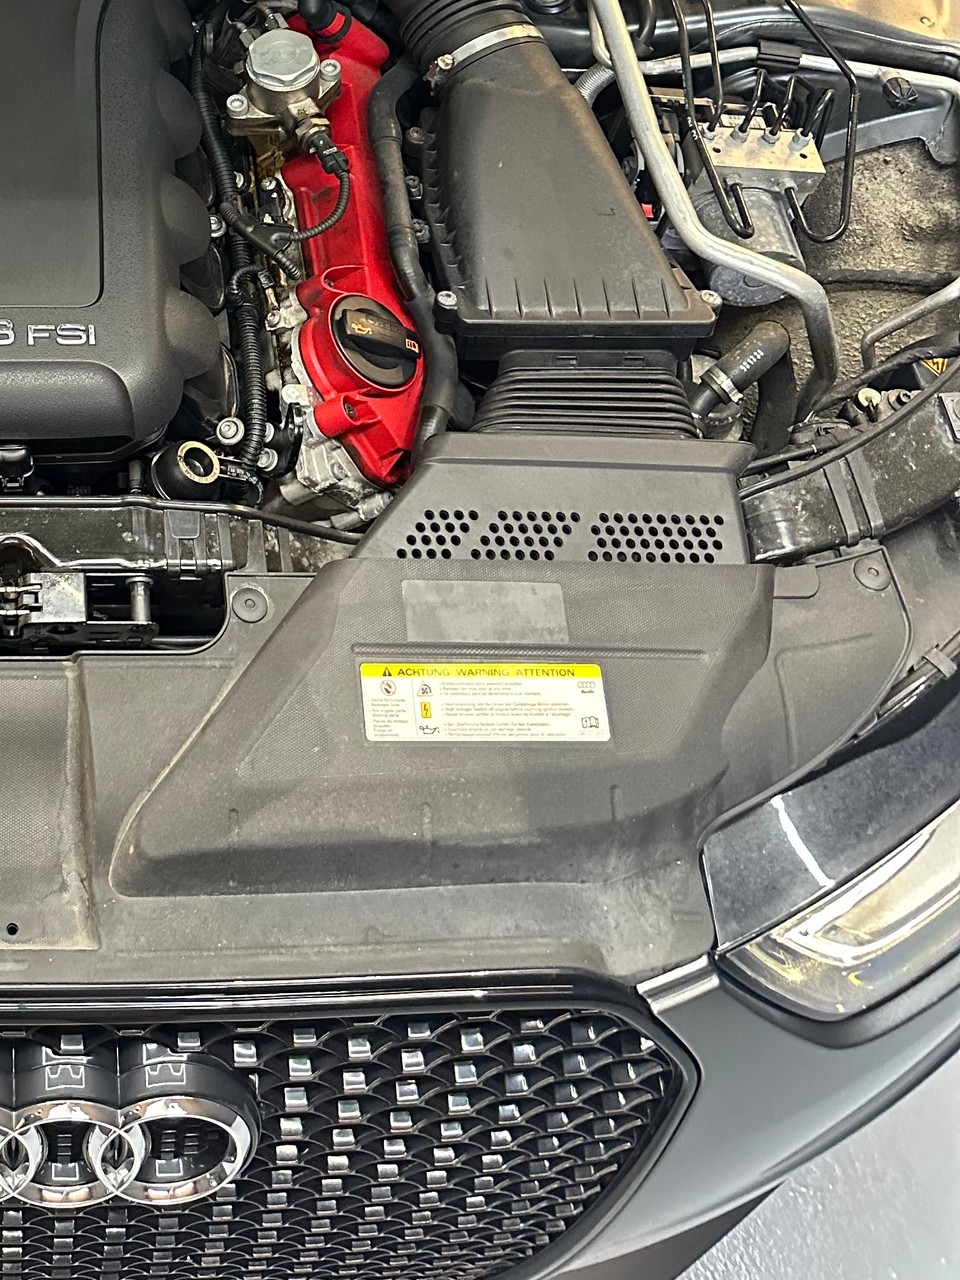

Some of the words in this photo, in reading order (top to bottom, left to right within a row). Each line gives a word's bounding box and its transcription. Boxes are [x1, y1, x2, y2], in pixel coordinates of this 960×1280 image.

[27, 324, 97, 346] FSI
[397, 668, 450, 677] ACHTUNG
[456, 668, 510, 677] WARNING
[515, 668, 575, 677] ATTENTION
